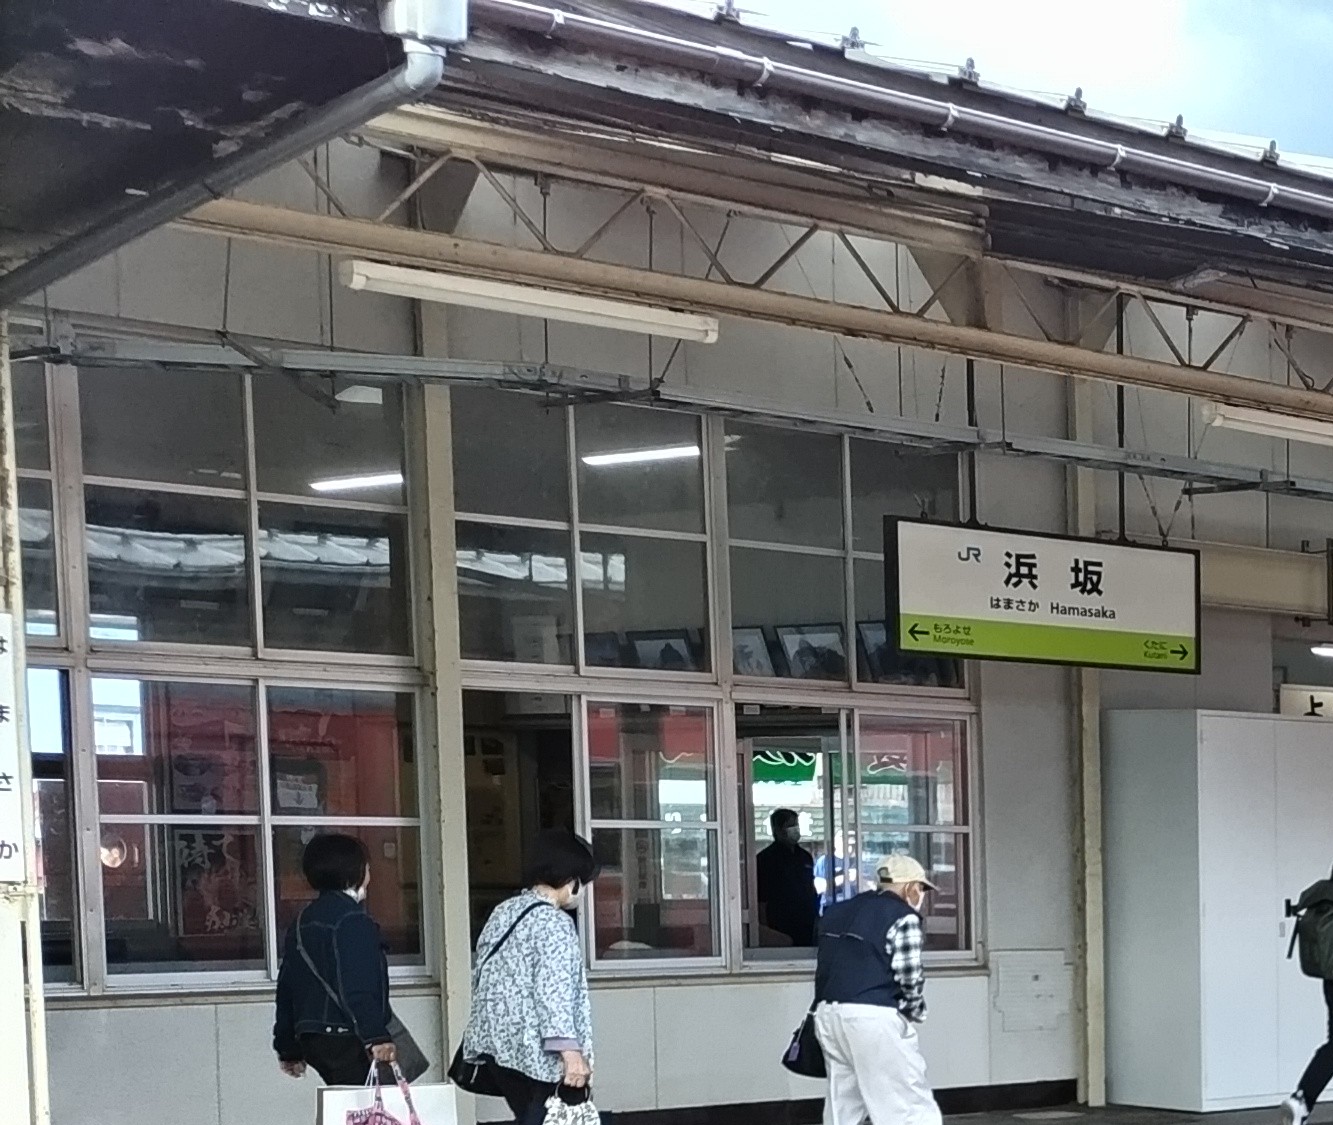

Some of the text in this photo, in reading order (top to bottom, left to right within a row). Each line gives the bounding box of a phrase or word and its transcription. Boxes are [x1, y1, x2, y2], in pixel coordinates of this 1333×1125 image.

[958, 547, 981, 563] JR
[1004, 551, 1104, 597] 浜坂
[990, 596, 1116, 620] はまさか Hamasaka
[933, 623, 971, 636] もろよせ
[933, 635, 975, 648] Moroyose
[1143, 639, 1168, 651] くたに
